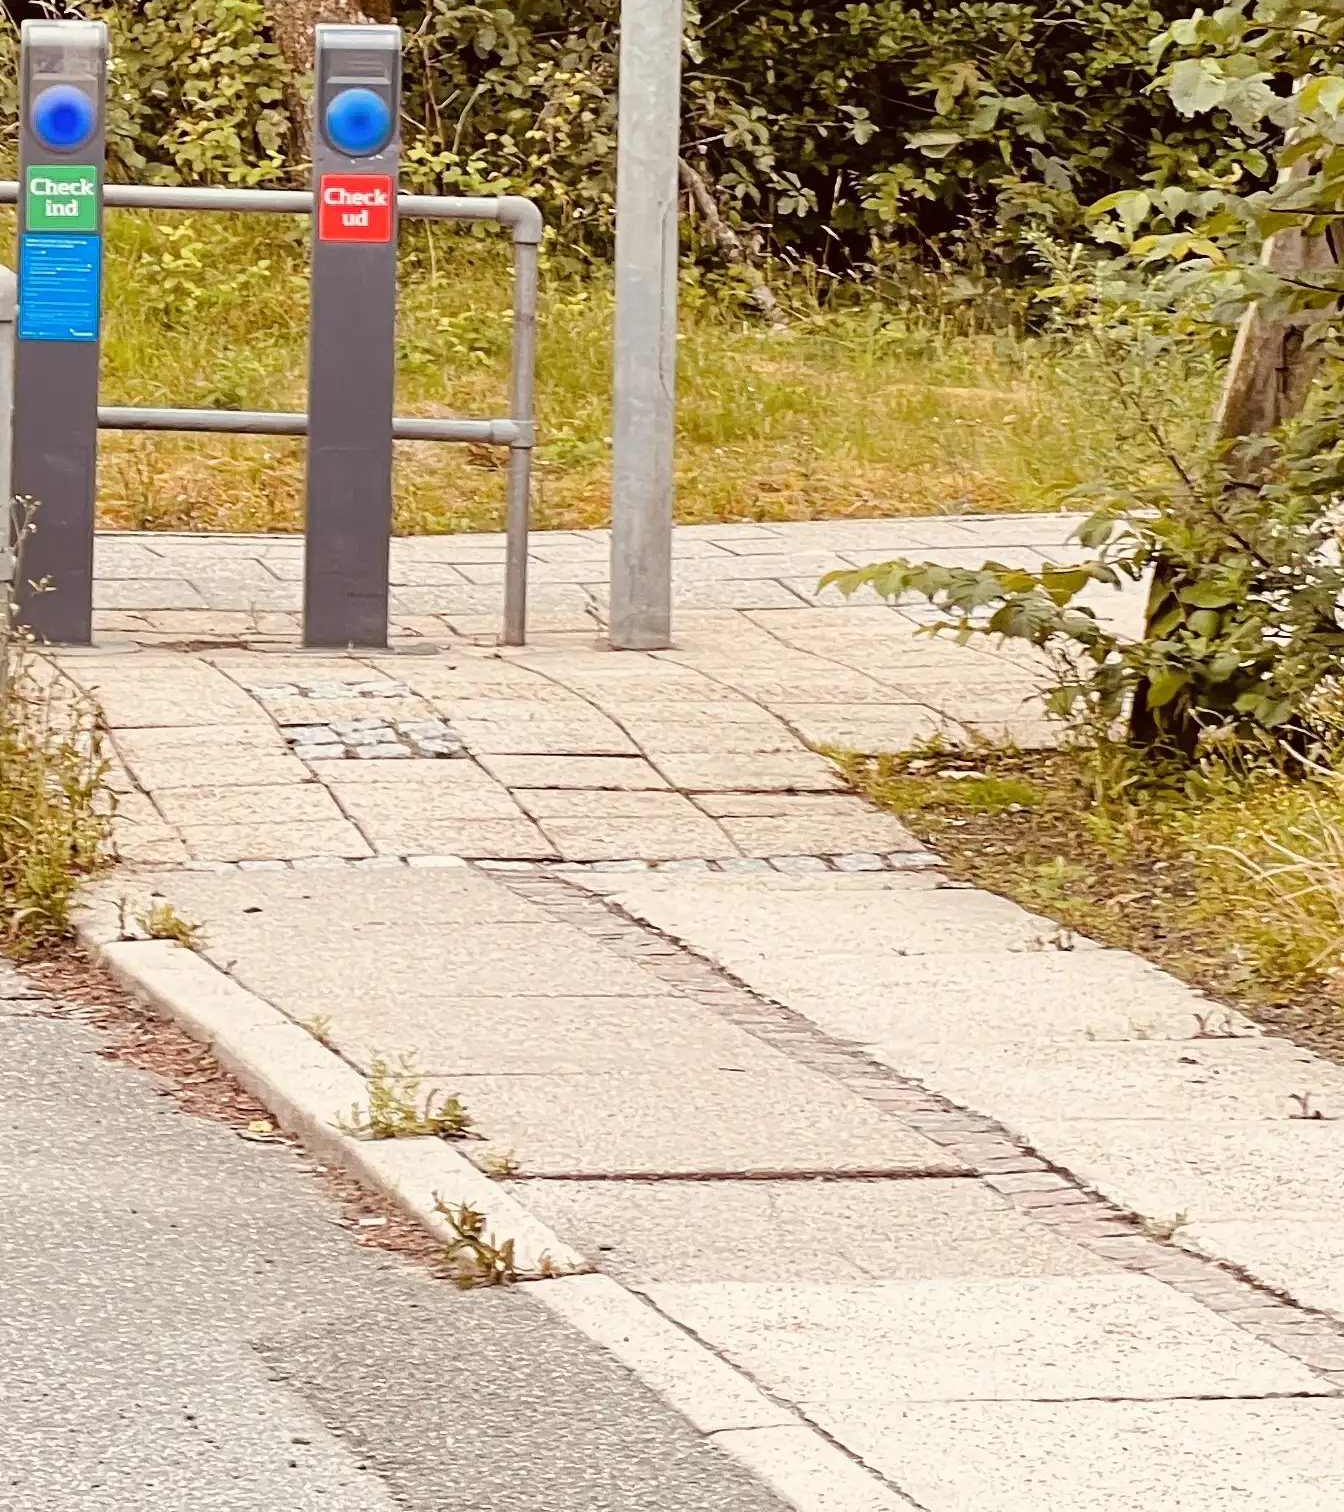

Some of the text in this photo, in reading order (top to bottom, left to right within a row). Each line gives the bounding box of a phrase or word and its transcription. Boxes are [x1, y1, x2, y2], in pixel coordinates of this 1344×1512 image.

[30, 178, 94, 196] Check
[324, 187, 388, 206] Check
[45, 199, 79, 217] ind
[342, 209, 369, 227] ud
